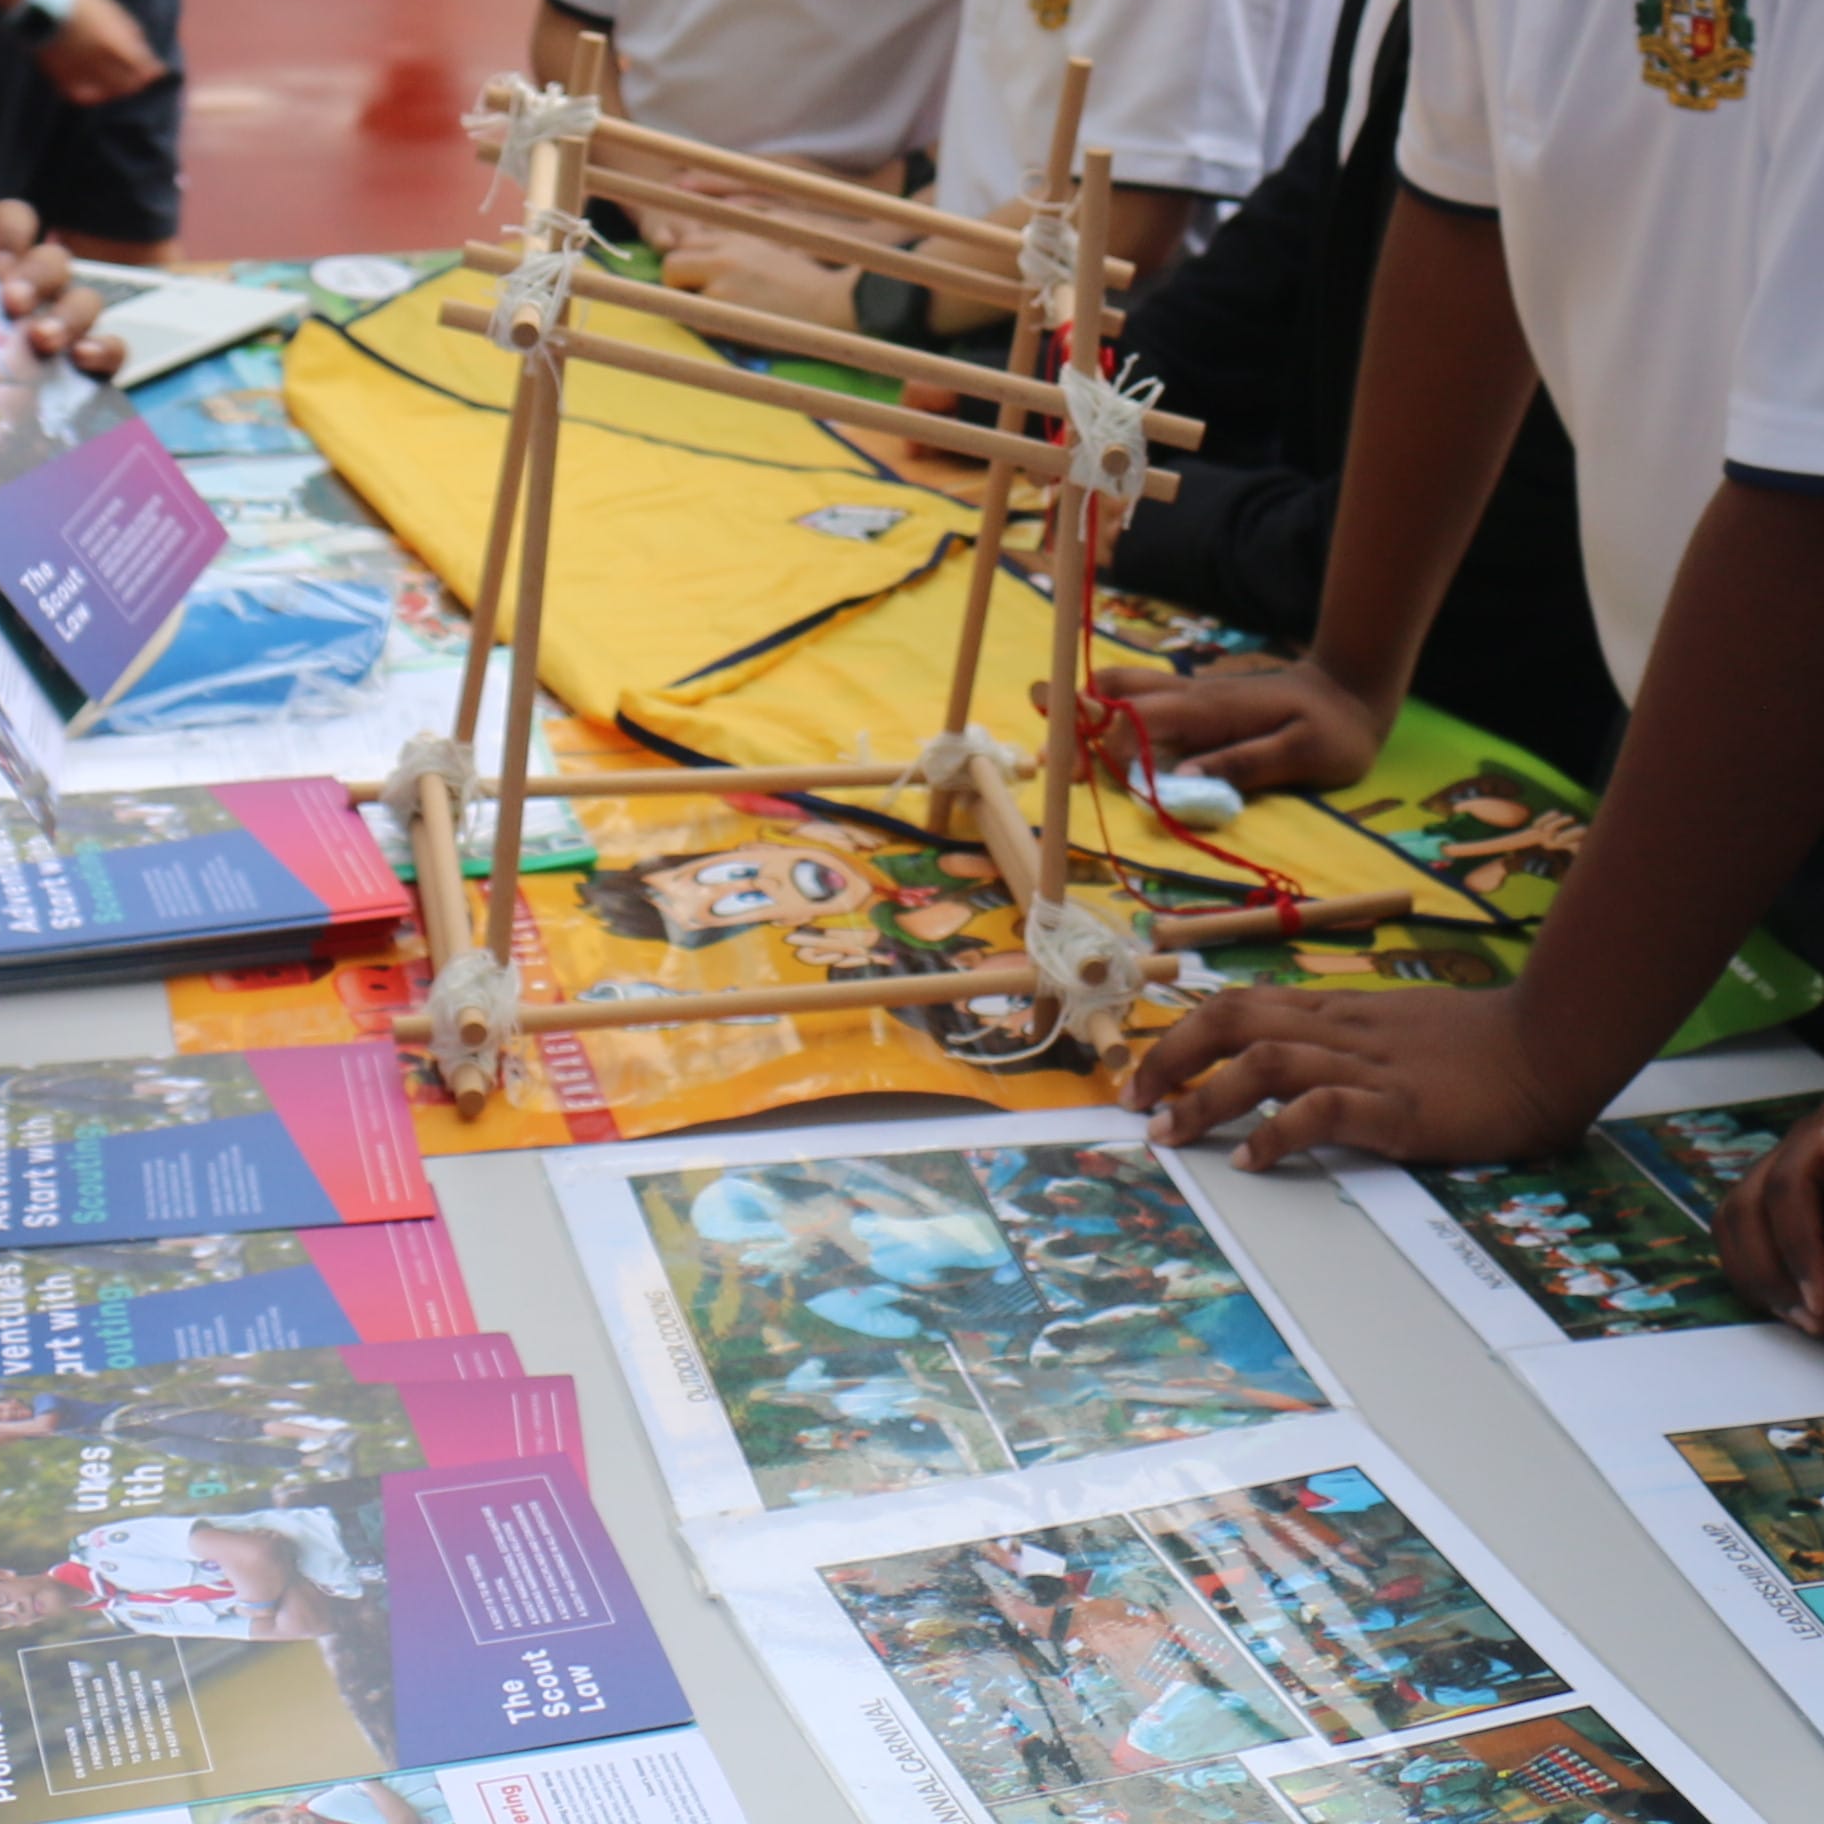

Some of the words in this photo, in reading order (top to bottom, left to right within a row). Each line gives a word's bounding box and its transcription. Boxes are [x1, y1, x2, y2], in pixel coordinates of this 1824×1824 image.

[38, 565, 86, 620] Scout
[55, 601, 92, 643] Law
[37, 876, 84, 930] Start
[17, 1113, 56, 1165] with
[22, 1166, 61, 1227] Start
[35, 1272, 79, 1332] with
[643, 1288, 683, 1343] COOKING
[665, 1343, 709, 1403] OUTDOOR
[74, 1445, 112, 1512] ures
[120, 1462, 165, 1508] ith
[1701, 1523, 1751, 1562] CAMP
[1737, 1563, 1823, 1640] LEADERSHIP
[501, 1679, 536, 1725] The
[521, 1648, 572, 1718] Scout
[567, 1665, 607, 1713] Law
[859, 1697, 927, 1774] CARNIVAL
[911, 1773, 969, 1824] NNIAL
